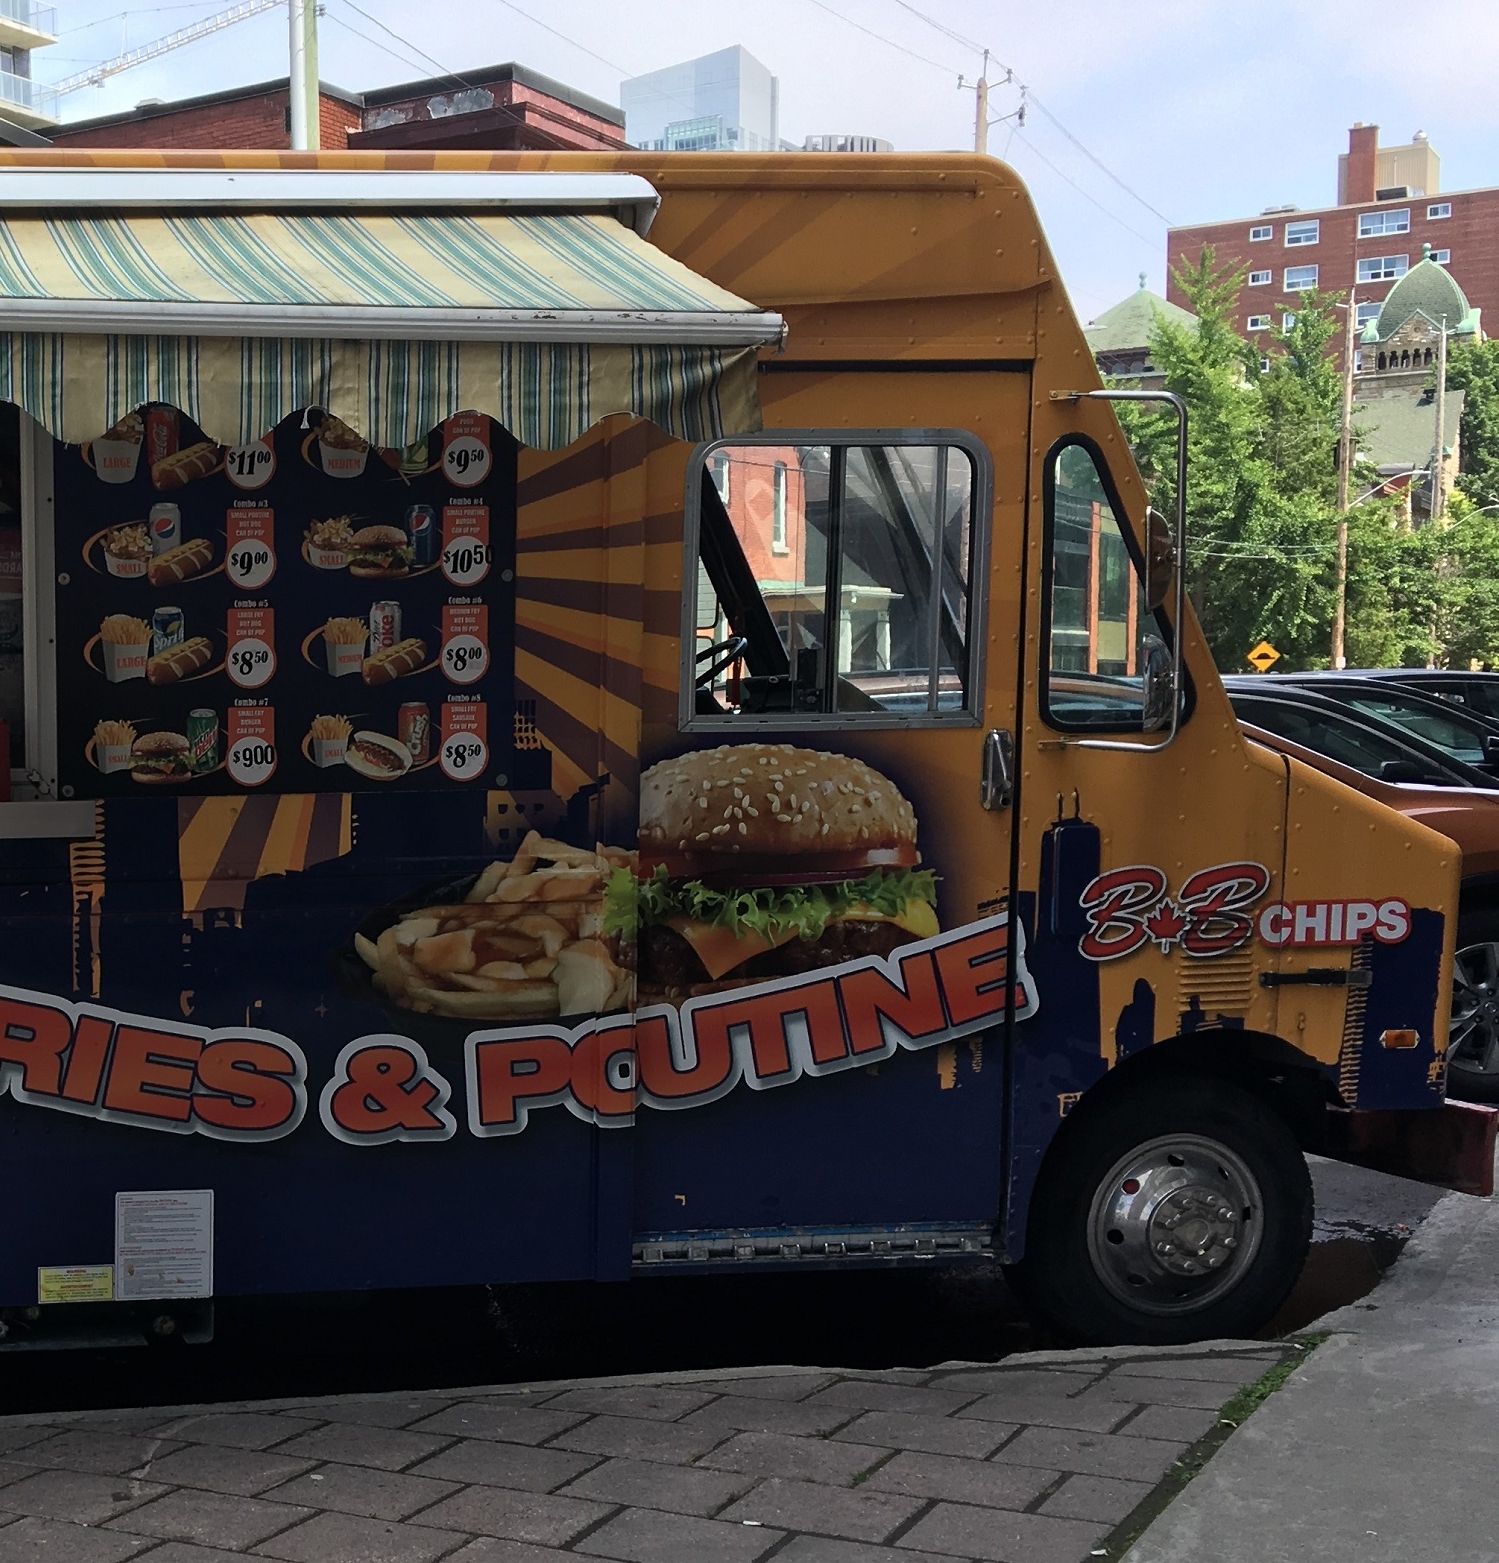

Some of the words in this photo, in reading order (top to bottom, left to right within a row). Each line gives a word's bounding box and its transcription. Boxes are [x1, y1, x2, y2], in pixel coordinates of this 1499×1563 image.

[233, 500, 257, 508] Combo
[258, 500, 269, 508] #3
[234, 600, 257, 608] Combo
[258, 599, 269, 608] #5
[448, 596, 471, 605] Combo
[116, 656, 146, 669] LARGE
[234, 698, 257, 707] Combo
[258, 698, 269, 706] #7
[447, 694, 470, 702] Combo
[1259, 900, 1409, 943] CHIPS
[329, 1043, 452, 1134] &
[472, 928, 1030, 1128] POUTINE
